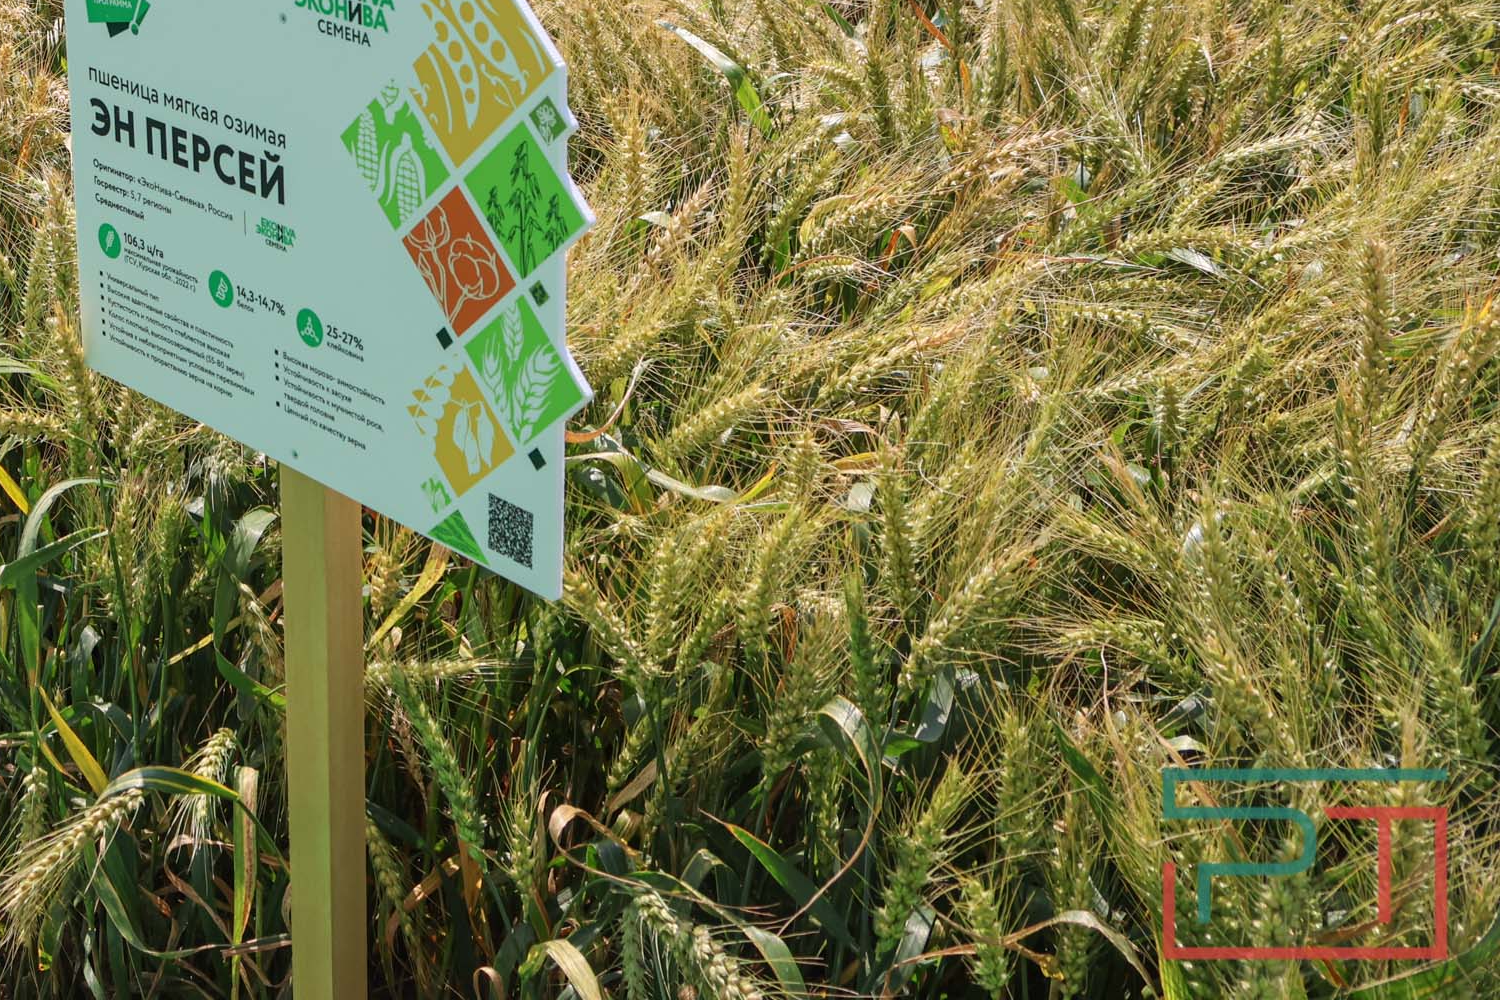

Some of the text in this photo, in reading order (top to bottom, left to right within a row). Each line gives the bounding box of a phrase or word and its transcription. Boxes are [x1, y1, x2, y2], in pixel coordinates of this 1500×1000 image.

[317, 19, 371, 48] СЕМЕНА
[88, 67, 287, 150] пшеница мягкая озимая
[89, 98, 286, 206] ЭН ПЕРСЕЙ
[93, 158, 136, 183] Оригинатор:
[208, 203, 233, 221] Россия
[94, 175, 130, 198] Госреестр:
[142, 197, 172, 215] регионы
[95, 193, 145, 220] Среднеспелый
[123, 232, 164, 259] 106,3 ц/га
[236, 285, 286, 316] 14,3-14,7%
[326, 324, 364, 351] 25-27%
